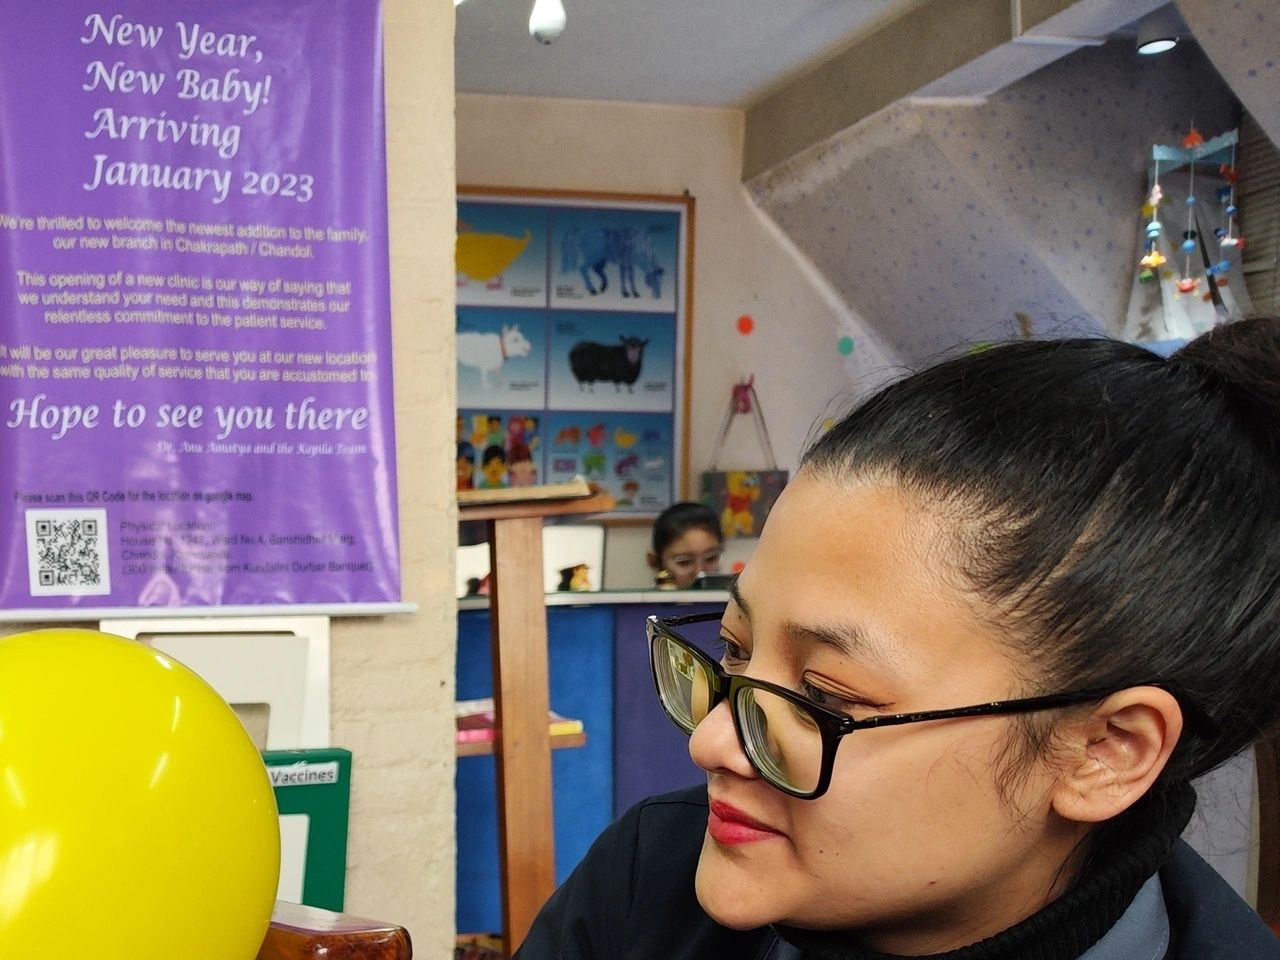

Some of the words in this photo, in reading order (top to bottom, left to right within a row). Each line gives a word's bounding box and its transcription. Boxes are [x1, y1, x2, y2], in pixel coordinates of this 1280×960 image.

[80, 13, 164, 49] New
[176, 21, 263, 64] Year,
[82, 60, 165, 95] New
[176, 68, 272, 116] Baby!
[84, 107, 241, 160] Arriving
[83, 153, 232, 204] January
[241, 170, 314, 202] 2023
[37, 215, 84, 231] thrilled
[86, 216, 102, 230] to
[104, 216, 163, 232] welcome
[165, 218, 186, 234] the
[189, 222, 234, 237] newest
[237, 223, 287, 239] addition
[289, 226, 302, 240] to
[304, 226, 324, 241] the
[53, 236, 77, 249] our
[79, 236, 110, 249] new
[112, 234, 158, 250] branch
[161, 237, 174, 251] in
[17, 271, 46, 286] This
[49, 272, 105, 289] opening
[108, 271, 123, 286] of
[125, 274, 135, 286] a
[137, 274, 166, 287] new
[167, 274, 200, 290] clinic
[202, 276, 213, 290] is
[216, 278, 237, 291] our
[239, 279, 266, 295] way
[268, 277, 282, 293] of
[283, 279, 324, 297] saying
[326, 280, 352, 295] that
[18, 293, 39, 305] we
[42, 291, 120, 306] understand
[123, 292, 153, 308] your
[155, 292, 187, 306] need
[190, 294, 215, 308] and
[217, 294, 240, 309] this
[242, 296, 327, 312] demonstrates
[328, 299, 351, 313] our
[44, 309, 112, 324] relentless
[114, 309, 195, 325] commitment
[196, 312, 209, 326] to
[211, 312, 232, 327] the
[234, 313, 278, 330] patient
[8, 345, 31, 360] will
[33, 345, 52, 360] be
[54, 348, 78, 360] our
[80, 346, 117, 364] great
[120, 346, 178, 363] pleasure
[179, 347, 193, 361] to
[195, 350, 231, 362] serve
[232, 350, 257, 365] you
[258, 350, 272, 363] at
[273, 351, 295, 364] our
[297, 351, 323, 365] new
[325, 350, 377, 365] location
[0, 363, 24, 378] with
[27, 364, 49, 378] the
[52, 366, 91, 379] same
[94, 364, 139, 381] quality
[141, 363, 156, 378] of
[158, 365, 203, 380] service
[205, 366, 231, 380] that
[232, 368, 257, 383] you
[258, 368, 281, 382] are
[282, 368, 357, 383] accustomed
[6, 393, 100, 440] Hope
[112, 399, 147, 430] to
[156, 403, 205, 430] see
[214, 404, 276, 441] you
[285, 396, 370, 432] there
[271, 769, 334, 784] Vaccines
